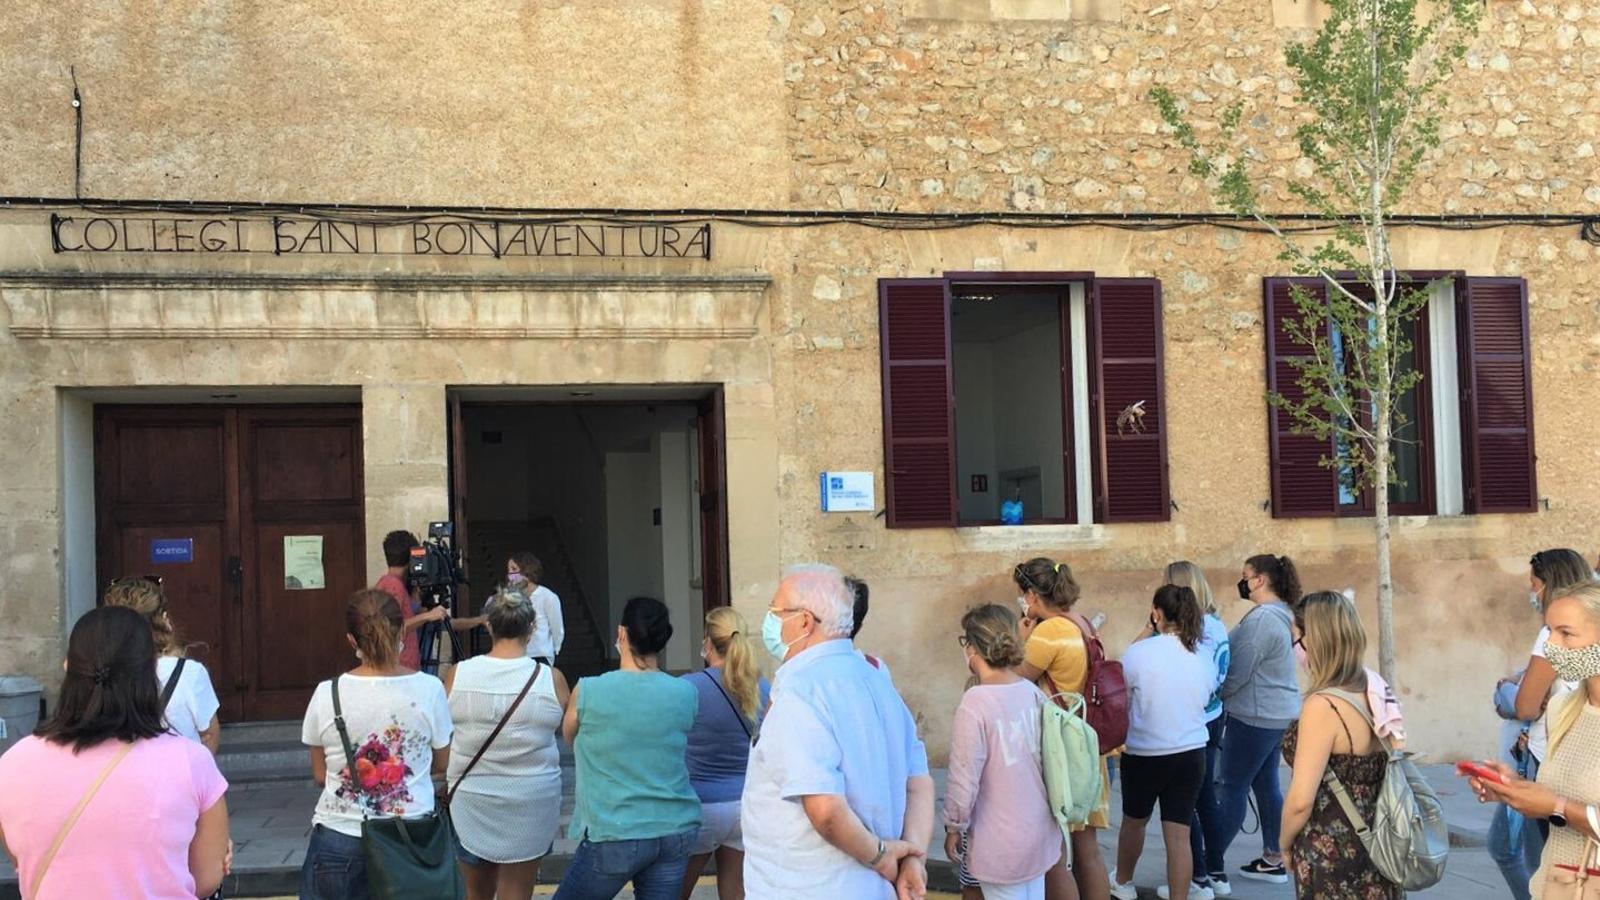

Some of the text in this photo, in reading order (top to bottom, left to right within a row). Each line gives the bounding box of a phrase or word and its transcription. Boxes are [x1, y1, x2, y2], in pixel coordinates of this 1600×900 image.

[275, 218, 394, 254] SANT
[413, 222, 707, 257] BONAVENTURA
[155, 547, 188, 555] SORTIDA
